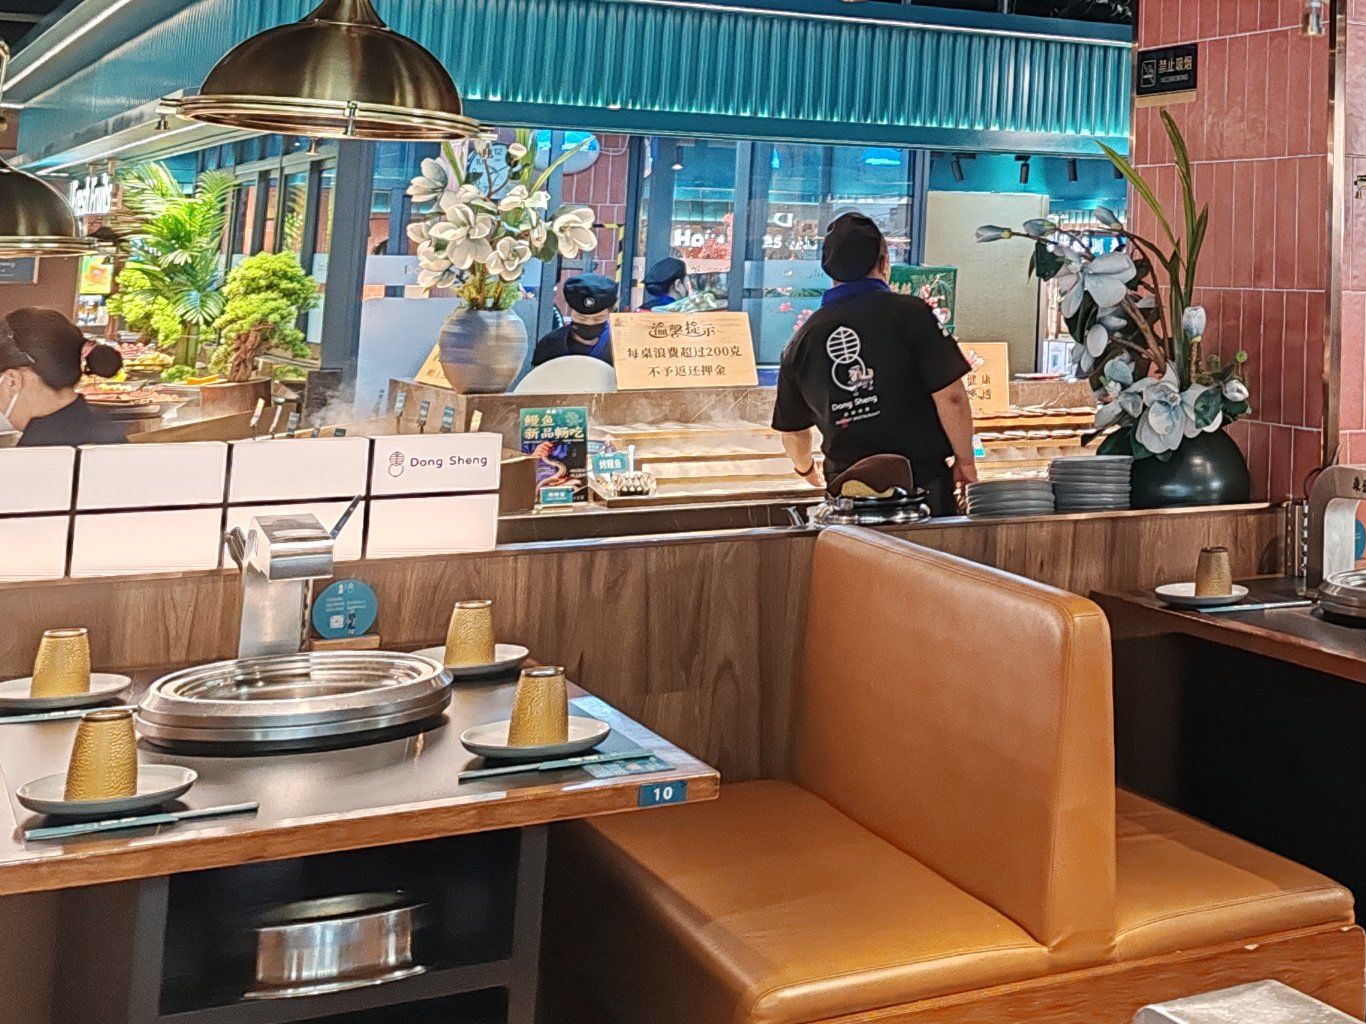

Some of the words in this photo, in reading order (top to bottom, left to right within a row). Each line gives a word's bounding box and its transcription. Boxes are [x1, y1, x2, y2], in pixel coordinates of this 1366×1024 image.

[1158, 56, 1192, 73] 禁止吸烟
[627, 345, 743, 359] 每桌浪费超过200克
[648, 364, 727, 378] 不予返还押金
[831, 401, 853, 411] Dong
[854, 395, 878, 406] Sheng
[524, 426, 584, 439] 新品畅吃
[410, 457, 443, 468] Dong
[449, 456, 488, 467] Sheng
[653, 787, 673, 800] 10
